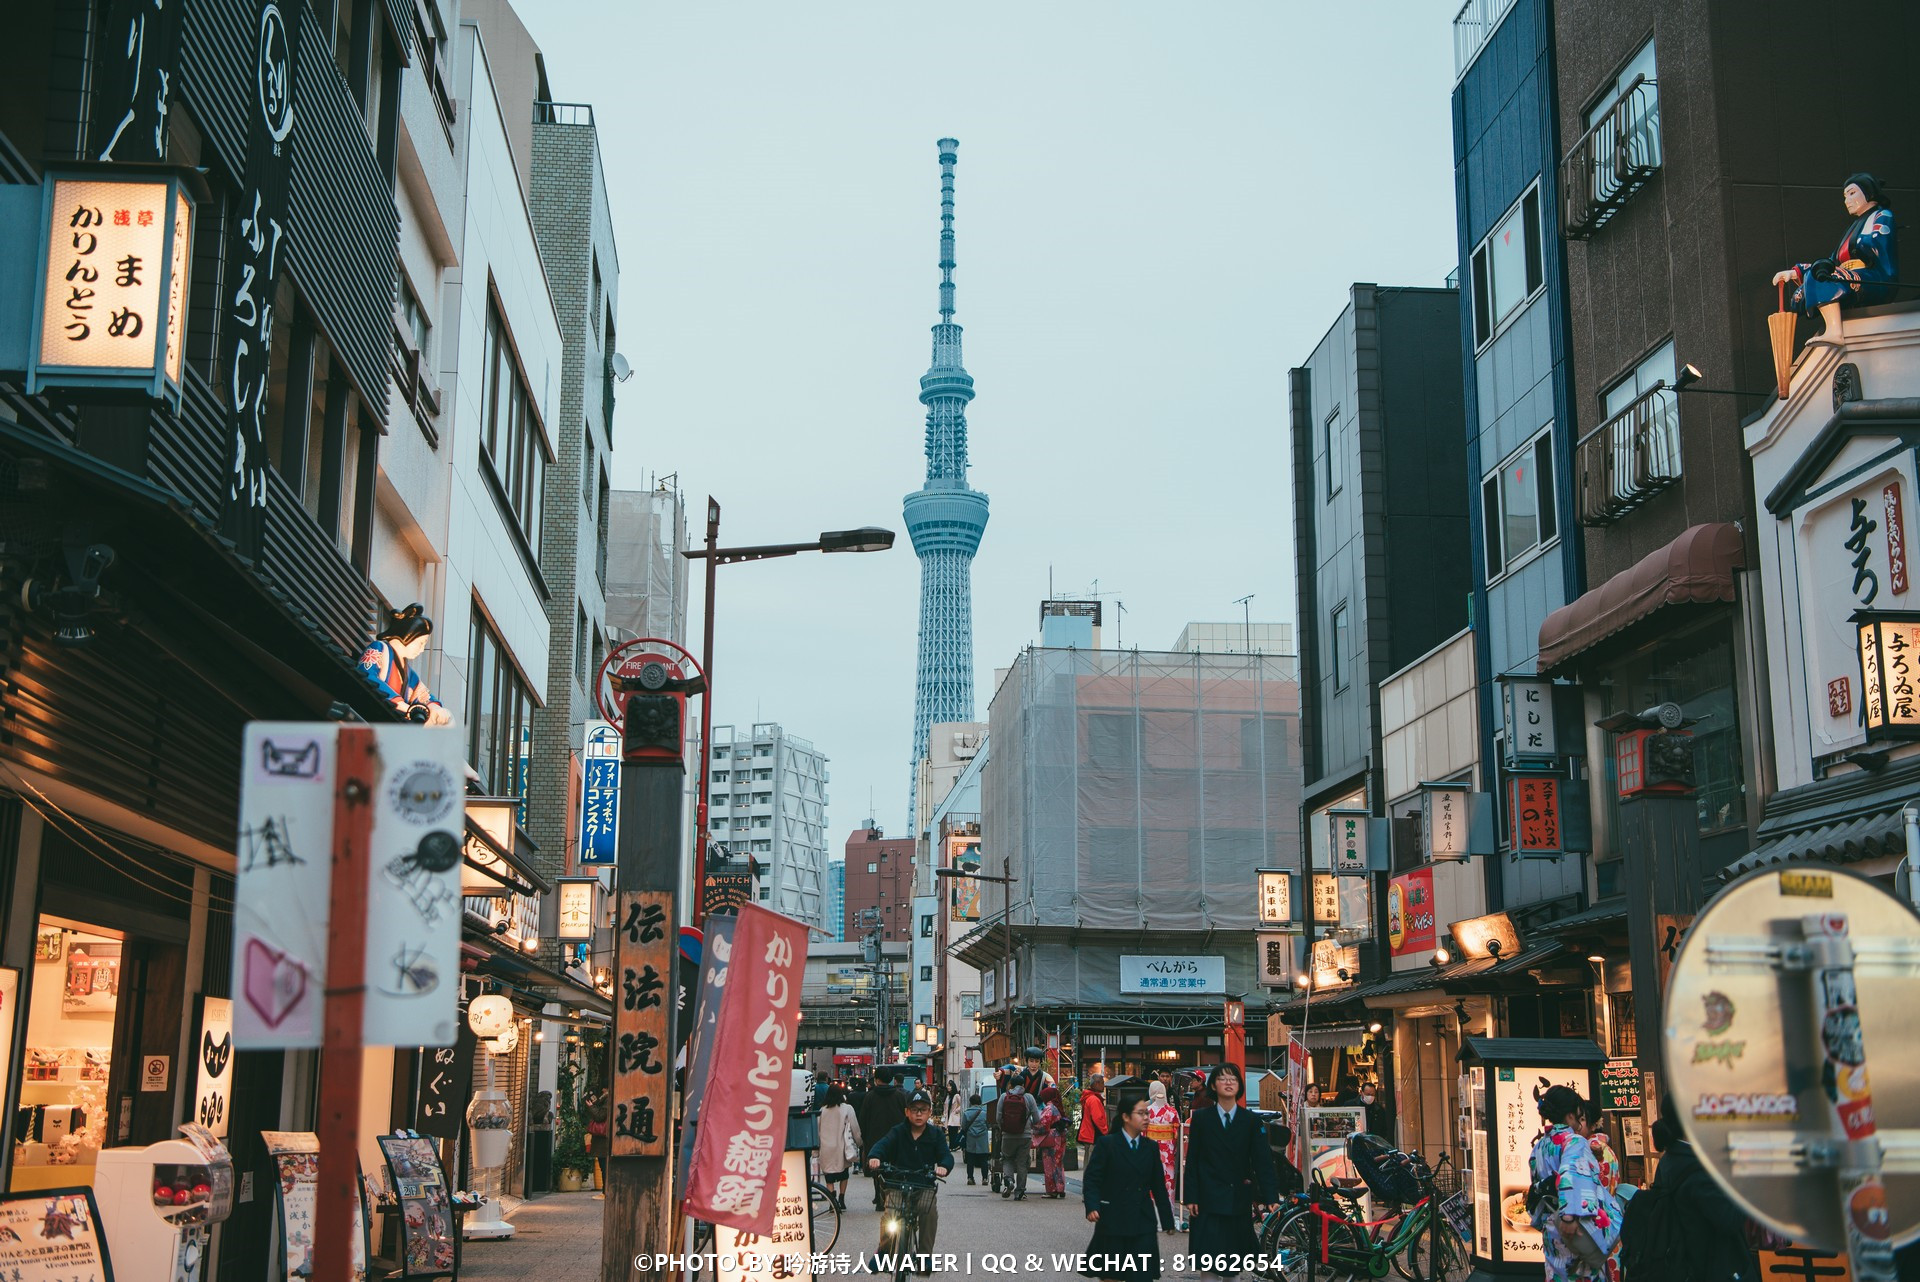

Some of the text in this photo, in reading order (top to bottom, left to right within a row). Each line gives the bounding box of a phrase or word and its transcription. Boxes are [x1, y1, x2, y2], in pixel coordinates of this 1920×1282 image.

[113, 209, 154, 227] 浅草
[64, 204, 103, 341] かりんとう
[107, 254, 143, 338] まめ
[1888, 632, 1918, 718] 与ろゐ屋
[1505, 694, 1513, 744] にしだ
[1526, 689, 1543, 747] にしだ
[585, 765, 602, 859] パソコンスクール
[602, 762, 615, 834] フォーティネット
[1543, 782, 1557, 847] ステーキハウス
[1345, 819, 1357, 860] 神戸の靴
[1522, 808, 1542, 846] のぶ
[728, 888, 750, 898] Welcome
[1266, 885, 1277, 918] 駐車場
[1140, 977, 1207, 988] 通常通り営業中
[1146, 961, 1198, 974] べんがら
[614, 902, 666, 1144] 伝法院通
[711, 931, 793, 1219] かりんとう饅頭
[289, 1210, 308, 1220] 浅草
[779, 1221, 803, 1230] Snacks
